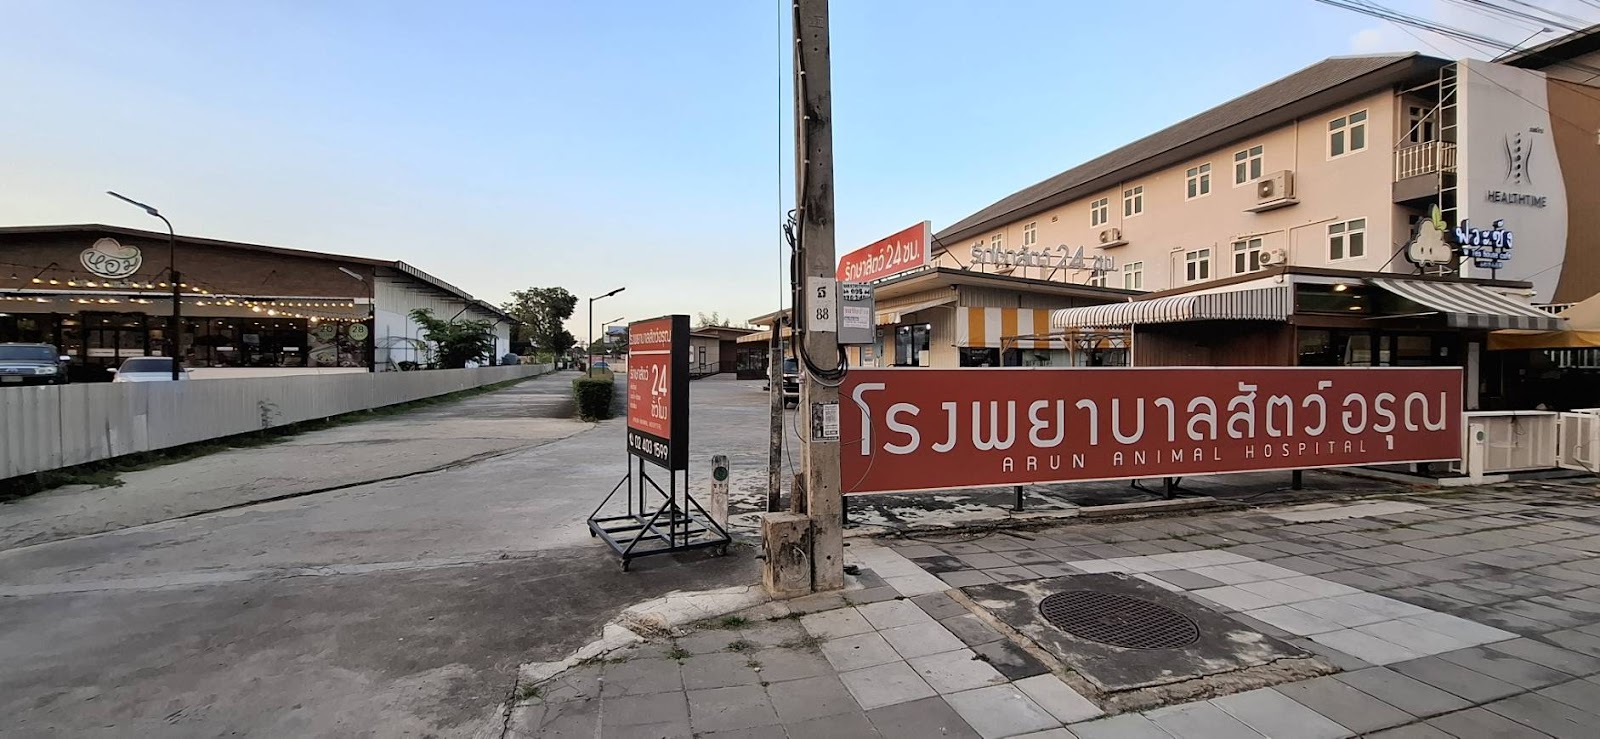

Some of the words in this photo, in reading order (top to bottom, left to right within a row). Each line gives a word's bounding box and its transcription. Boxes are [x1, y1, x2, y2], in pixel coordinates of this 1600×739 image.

[1487, 190, 1547, 208] HEALTHTIME
[844, 248, 884, 281] รักษาสัตว์
[885, 241, 901, 268] 24
[903, 239, 920, 264] ชม.
[1056, 244, 1085, 269] 24
[816, 307, 829, 320] 88
[652, 363, 668, 396] 24
[651, 395, 668, 420] ชั่วโมง
[635, 434, 642, 450] 02
[642, 438, 653, 454] 403
[653, 441, 668, 461] 1599
[1002, 454, 1085, 472] ARUN
[1113, 446, 1222, 467] ANIMAL
[1246, 439, 1367, 459] HOSPITAL
